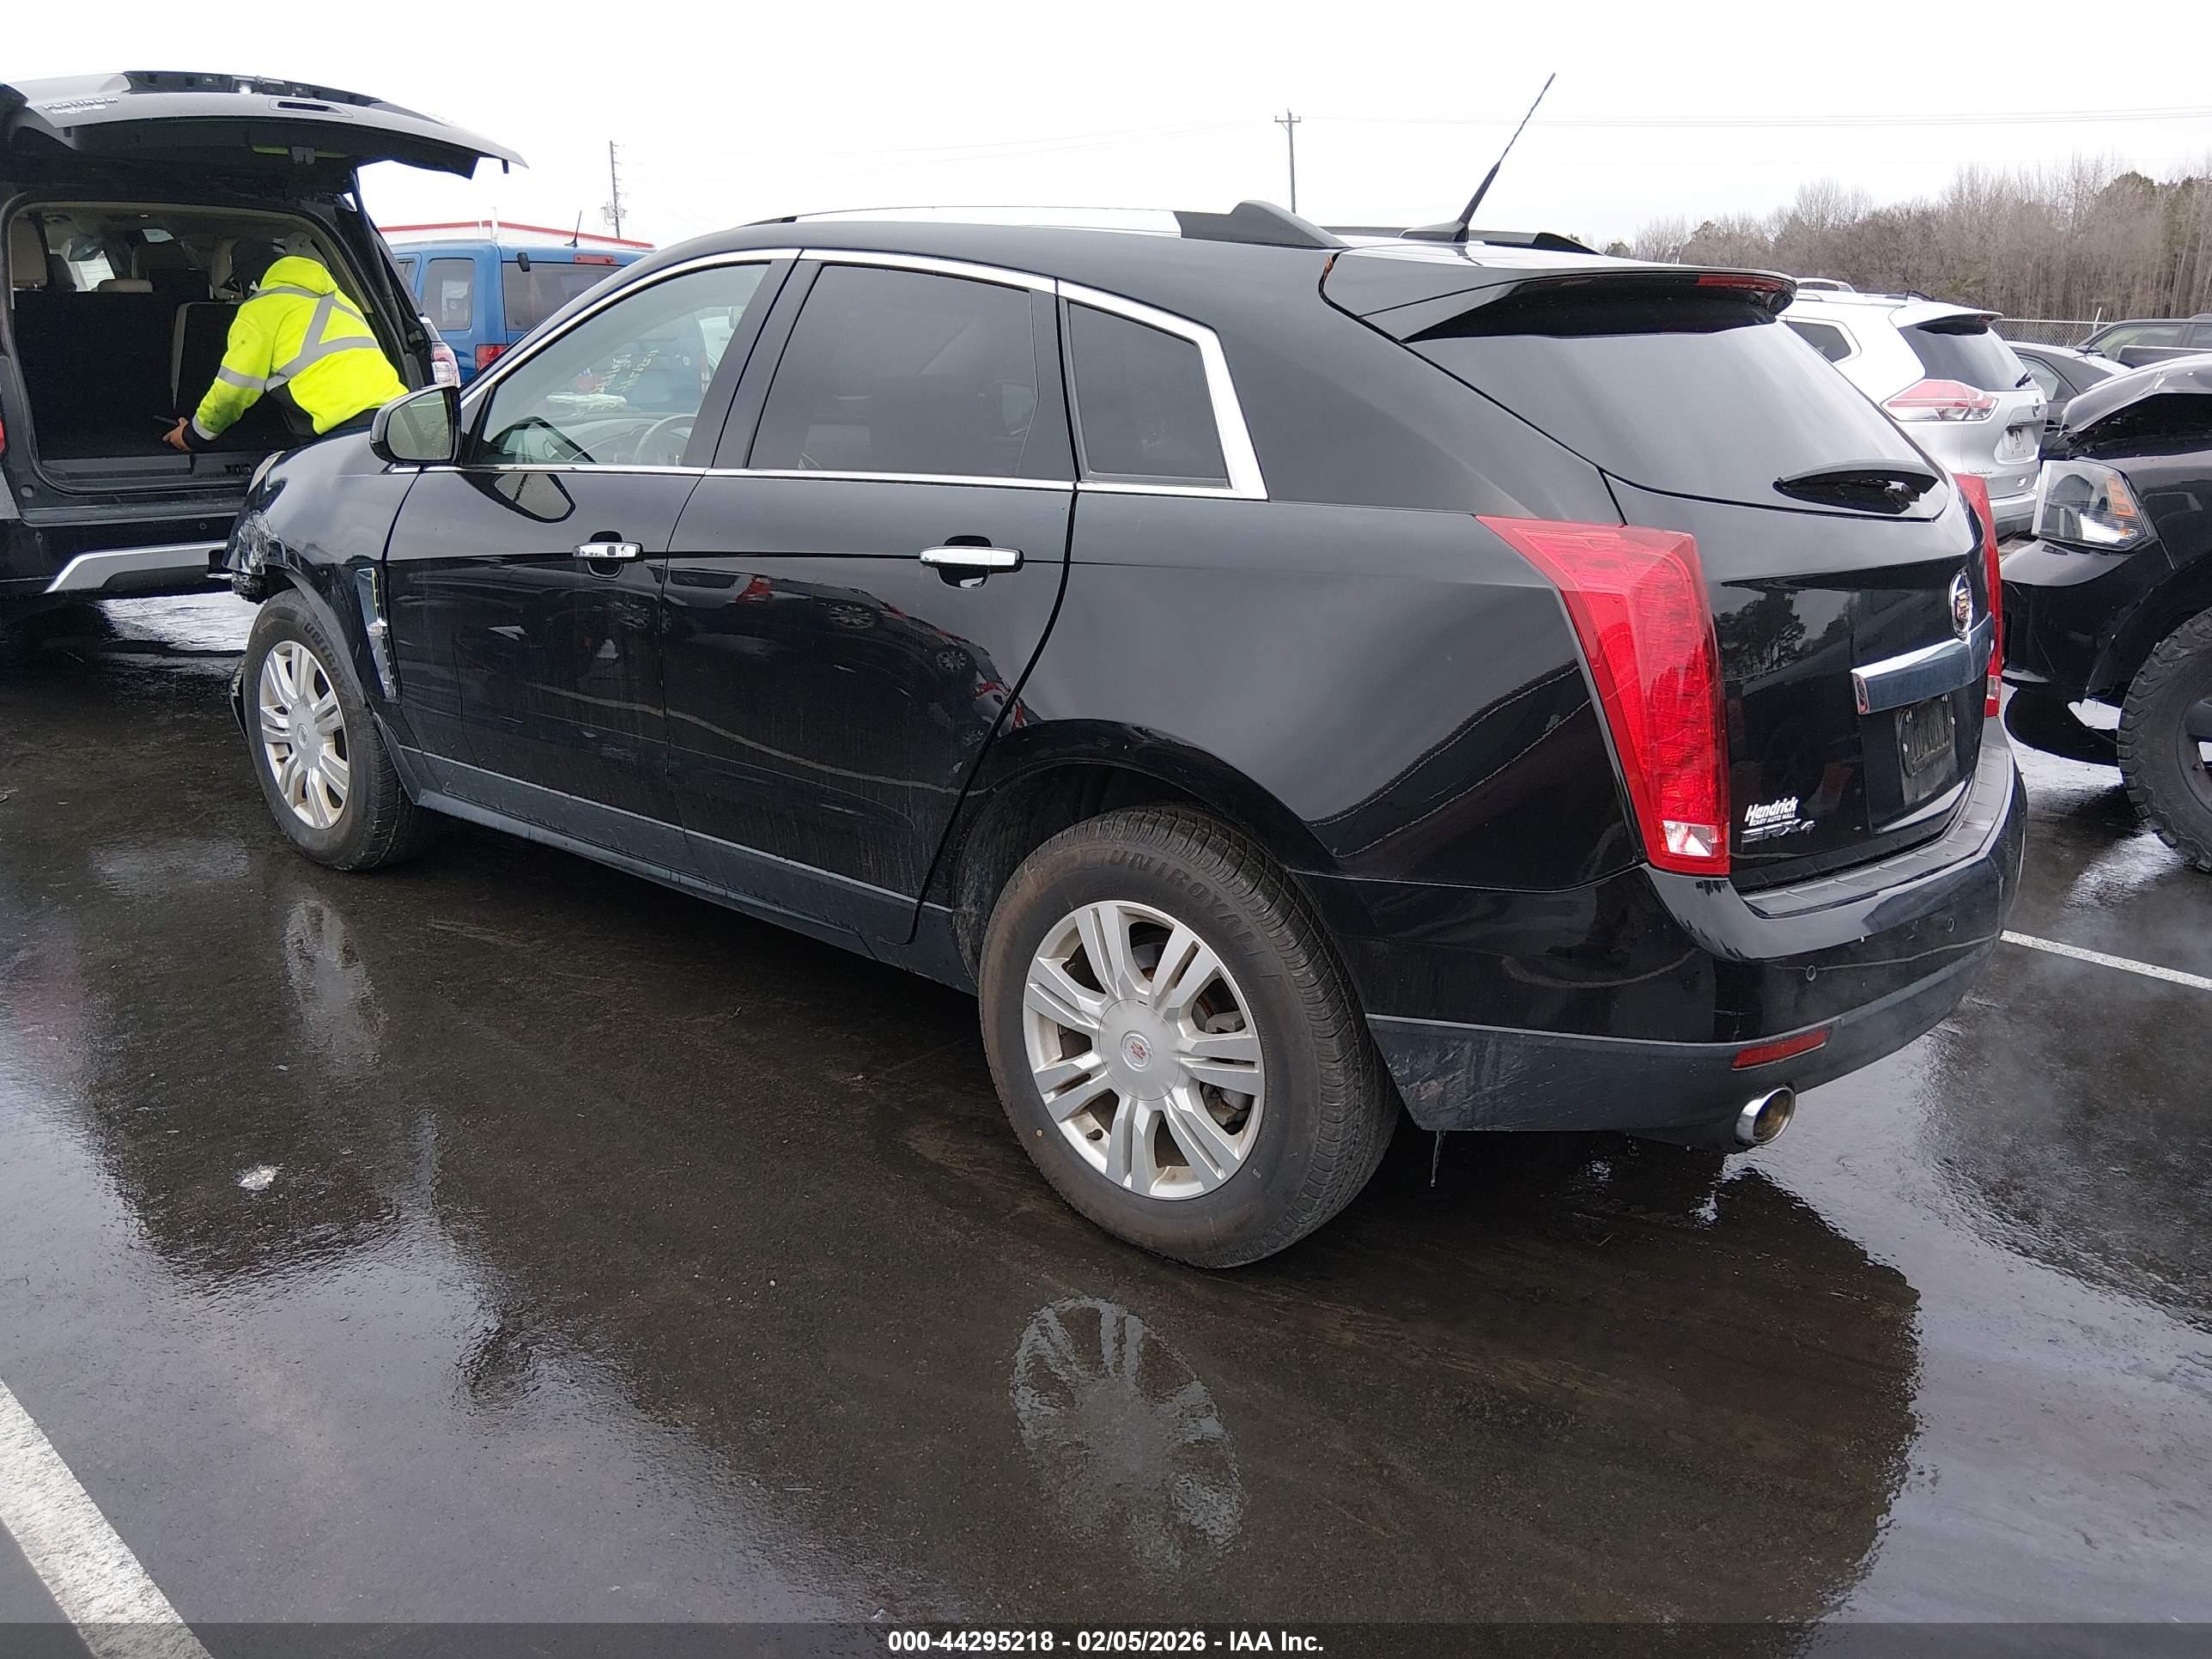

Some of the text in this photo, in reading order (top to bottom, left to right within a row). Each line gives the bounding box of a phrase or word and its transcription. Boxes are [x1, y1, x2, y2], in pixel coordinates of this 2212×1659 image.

[43, 97, 118, 110] PLATINUM
[1744, 796, 1799, 826] Hendrick
[1109, 850, 1266, 956] UNIROYAL
